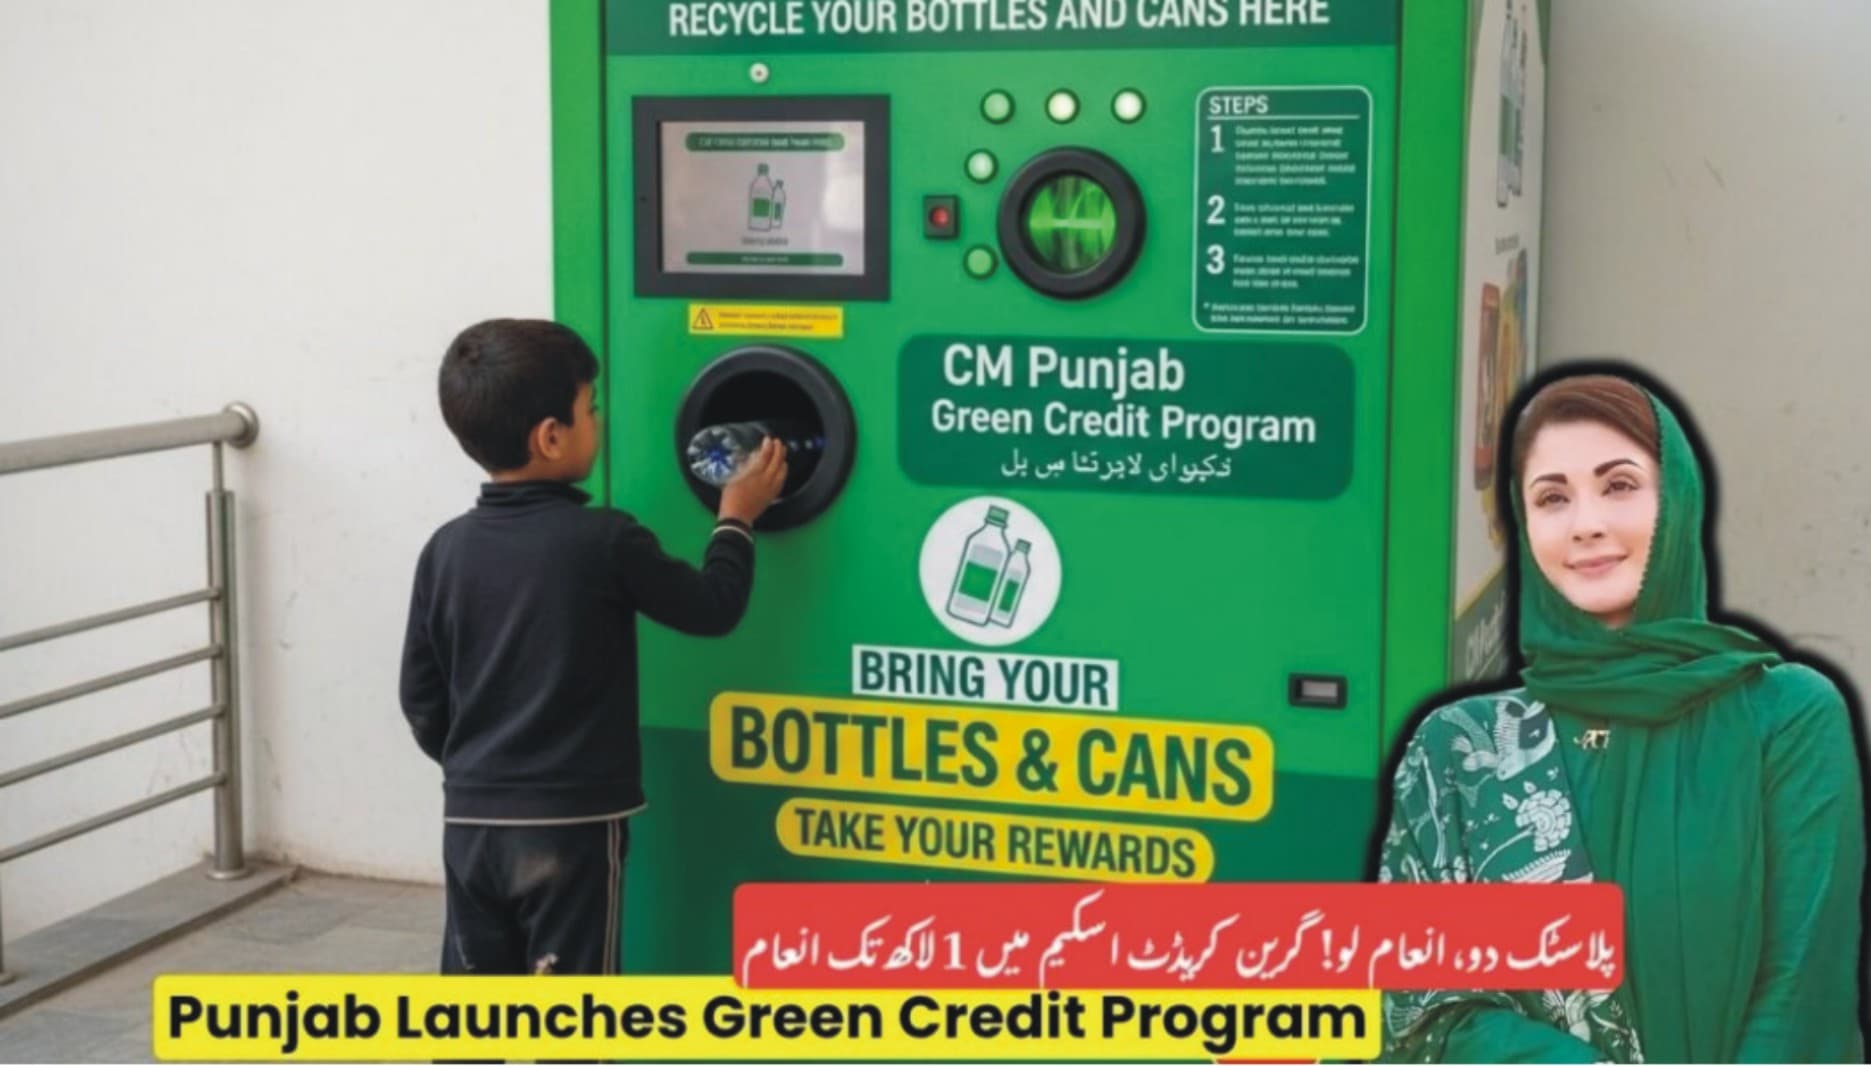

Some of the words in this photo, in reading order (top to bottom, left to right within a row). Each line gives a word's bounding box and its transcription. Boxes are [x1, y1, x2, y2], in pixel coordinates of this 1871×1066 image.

[669, 2, 804, 36] RECYCLE
[812, 1, 898, 34] YOUR
[907, 0, 1047, 32] BOTTLES
[1056, 0, 1127, 29] AND
[1137, 0, 1229, 28] CANS
[1239, 0, 1330, 25] HERE
[1209, 95, 1269, 114] STEPS
[1211, 125, 1225, 152] 1
[1207, 195, 1226, 224] 2
[1206, 244, 1225, 275] 3
[943, 344, 1012, 387] CM
[1029, 346, 1185, 400] Punjab
[931, 399, 1033, 434] Green
[1044, 402, 1150, 438] Credit
[1161, 406, 1316, 449] Program
[859, 650, 985, 699] BRING
[997, 658, 1110, 707] YOUR
[731, 705, 999, 789] BOTTLES
[1015, 728, 1059, 794] &
[1077, 728, 1252, 807] CANS
[795, 807, 885, 852] TAKE
[895, 816, 996, 862] YOUR
[1008, 824, 1197, 879] REWARDS
